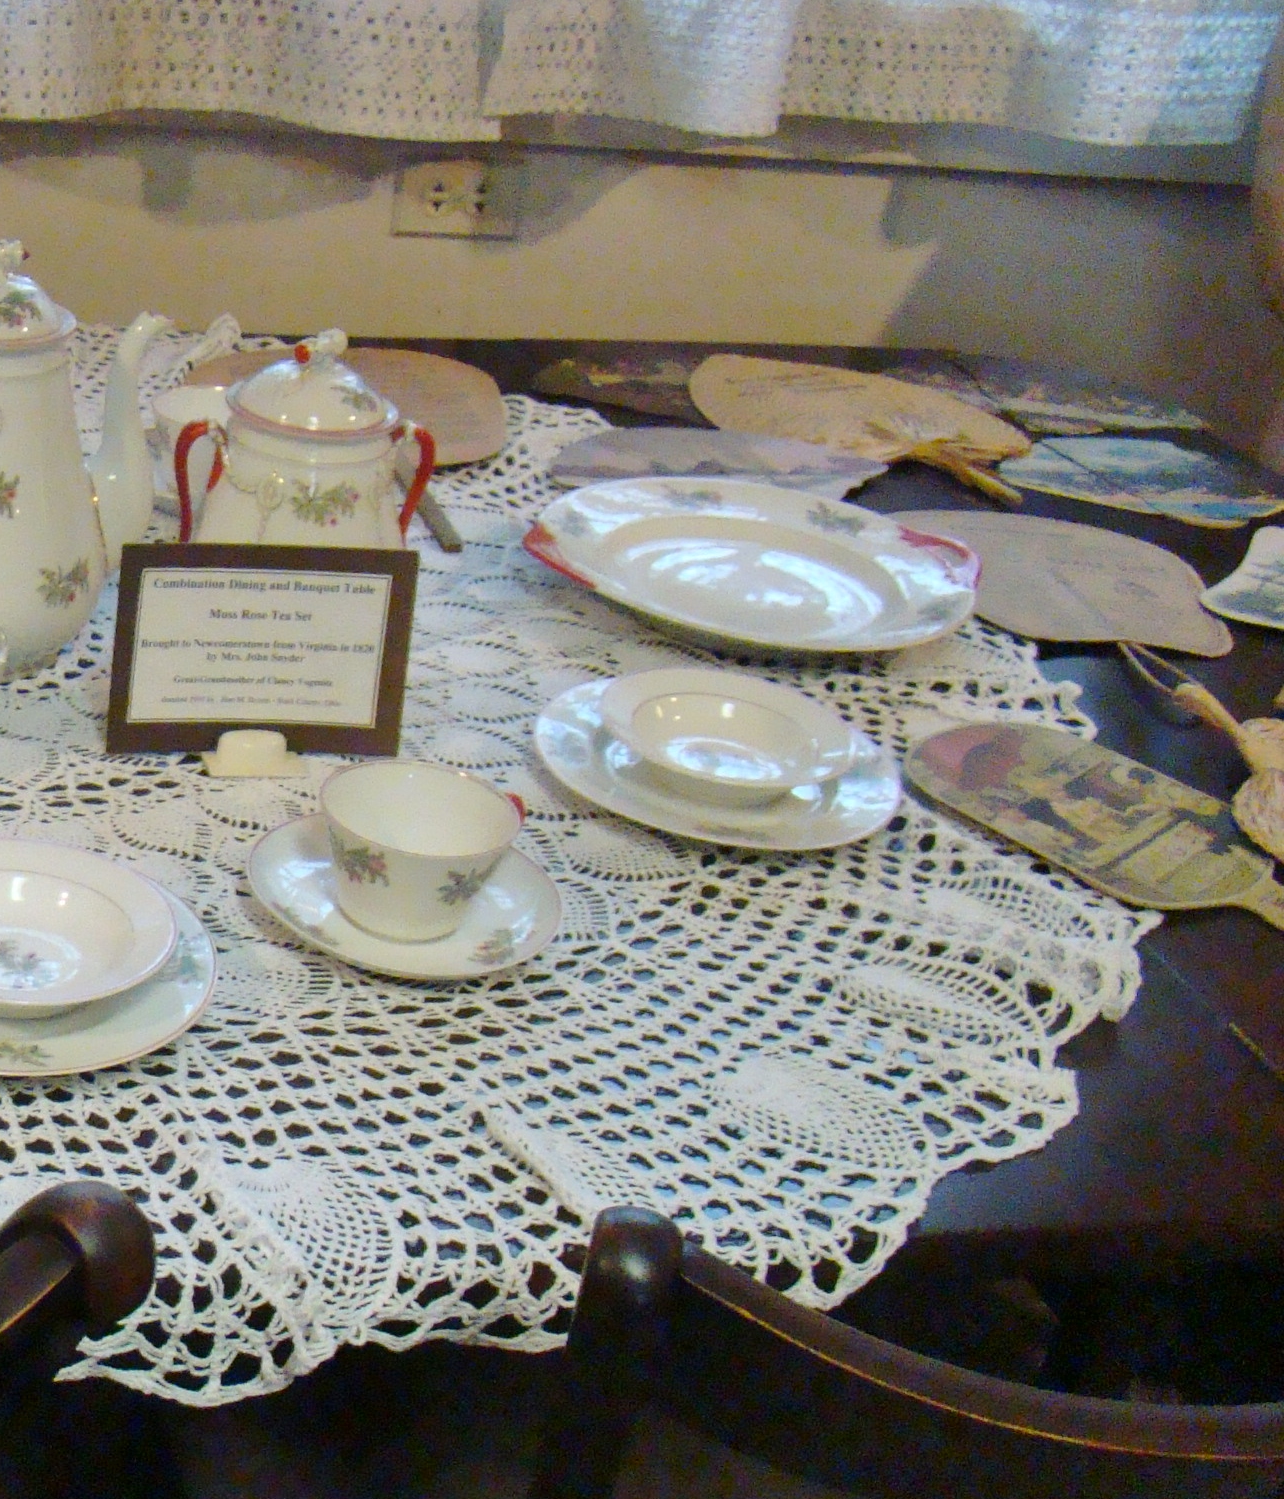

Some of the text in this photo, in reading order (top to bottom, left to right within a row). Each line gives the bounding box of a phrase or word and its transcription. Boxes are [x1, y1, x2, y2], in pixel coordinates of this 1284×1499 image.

[154, 578, 376, 594] Combination Dining and Banquet Table
[209, 609, 312, 621] Moss Rose Tea Set
[141, 639, 179, 650] Brought
